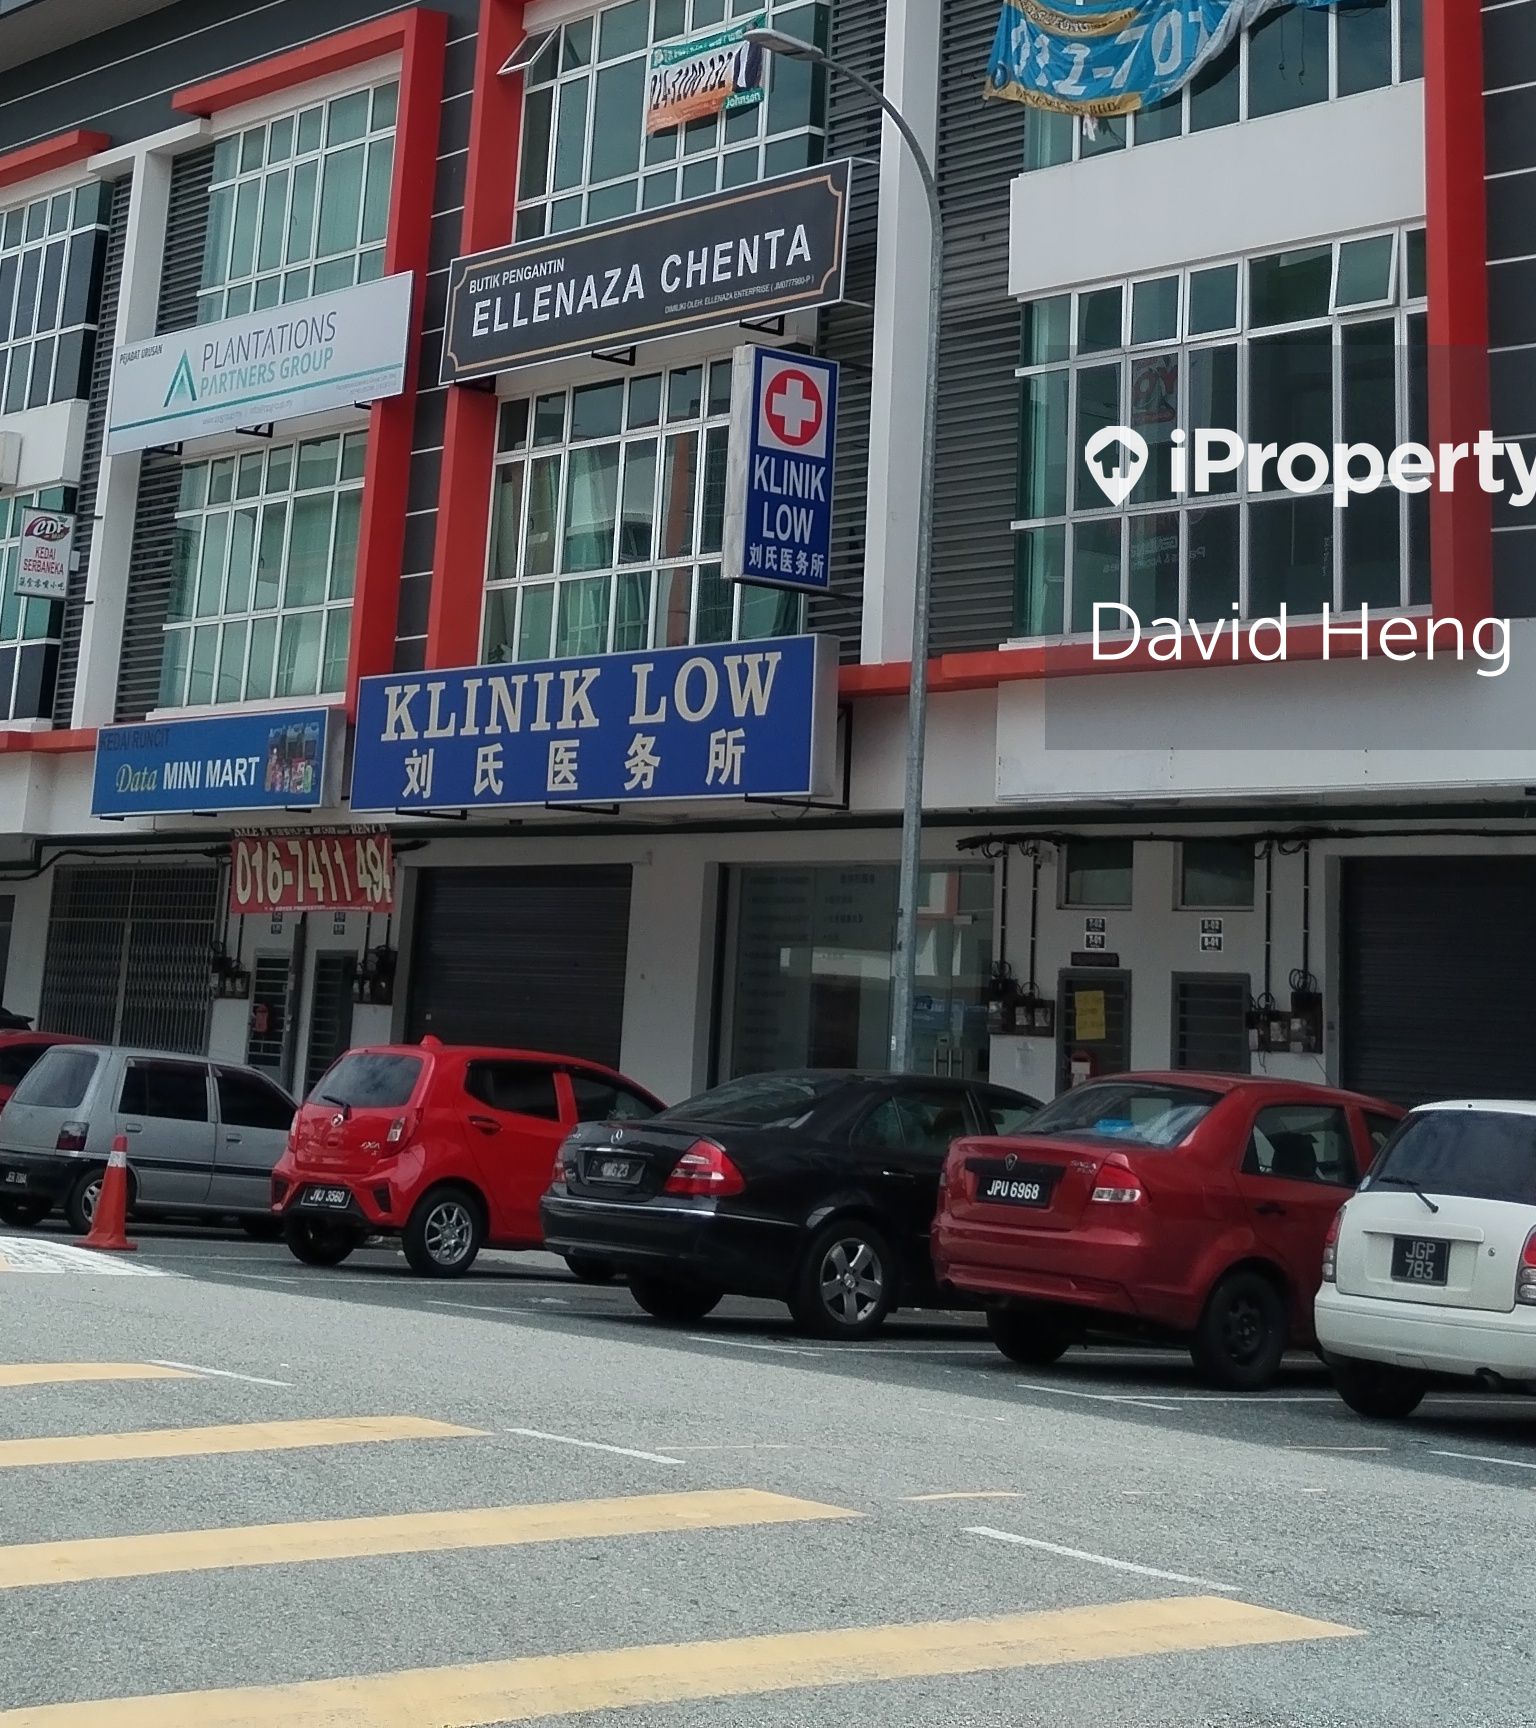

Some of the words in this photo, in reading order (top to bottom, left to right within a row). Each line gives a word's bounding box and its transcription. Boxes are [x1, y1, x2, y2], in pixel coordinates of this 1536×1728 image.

[726, 92, 762, 109] Johnson
[469, 272, 500, 294] BUTIK
[502, 258, 565, 287] PENGANTIN
[472, 264, 645, 337] ELLENAZA
[660, 224, 811, 293] CHENTA
[704, 294, 733, 306] ELLENAZA
[734, 284, 770, 299] ENTERPRISE
[202, 311, 337, 372] PLANTATIONS
[200, 360, 276, 398] PARTNERS
[279, 346, 334, 380] GROUP
[753, 454, 826, 502] KLINIK
[762, 501, 814, 545] LOW
[23, 558, 64, 574] SERBANEKA
[35, 546, 56, 560] KEDAI
[749, 542, 824, 579] 刘氏医务所
[381, 667, 601, 742] KLINIK
[629, 652, 781, 725] LOW
[100, 730, 131, 752] KEDAI
[131, 727, 170, 749] RUNCIT
[116, 763, 158, 793] Data
[162, 760, 200, 790] MINI
[205, 756, 260, 790] MART
[401, 728, 747, 799] 刘氏医务所
[236, 839, 352, 905] 016-7411
[987, 1180, 1009, 1196] JPU
[1010, 1182, 1040, 1200] 6968
[1405, 1241, 1436, 1260] JGP
[1405, 1259, 1434, 1280] 783
